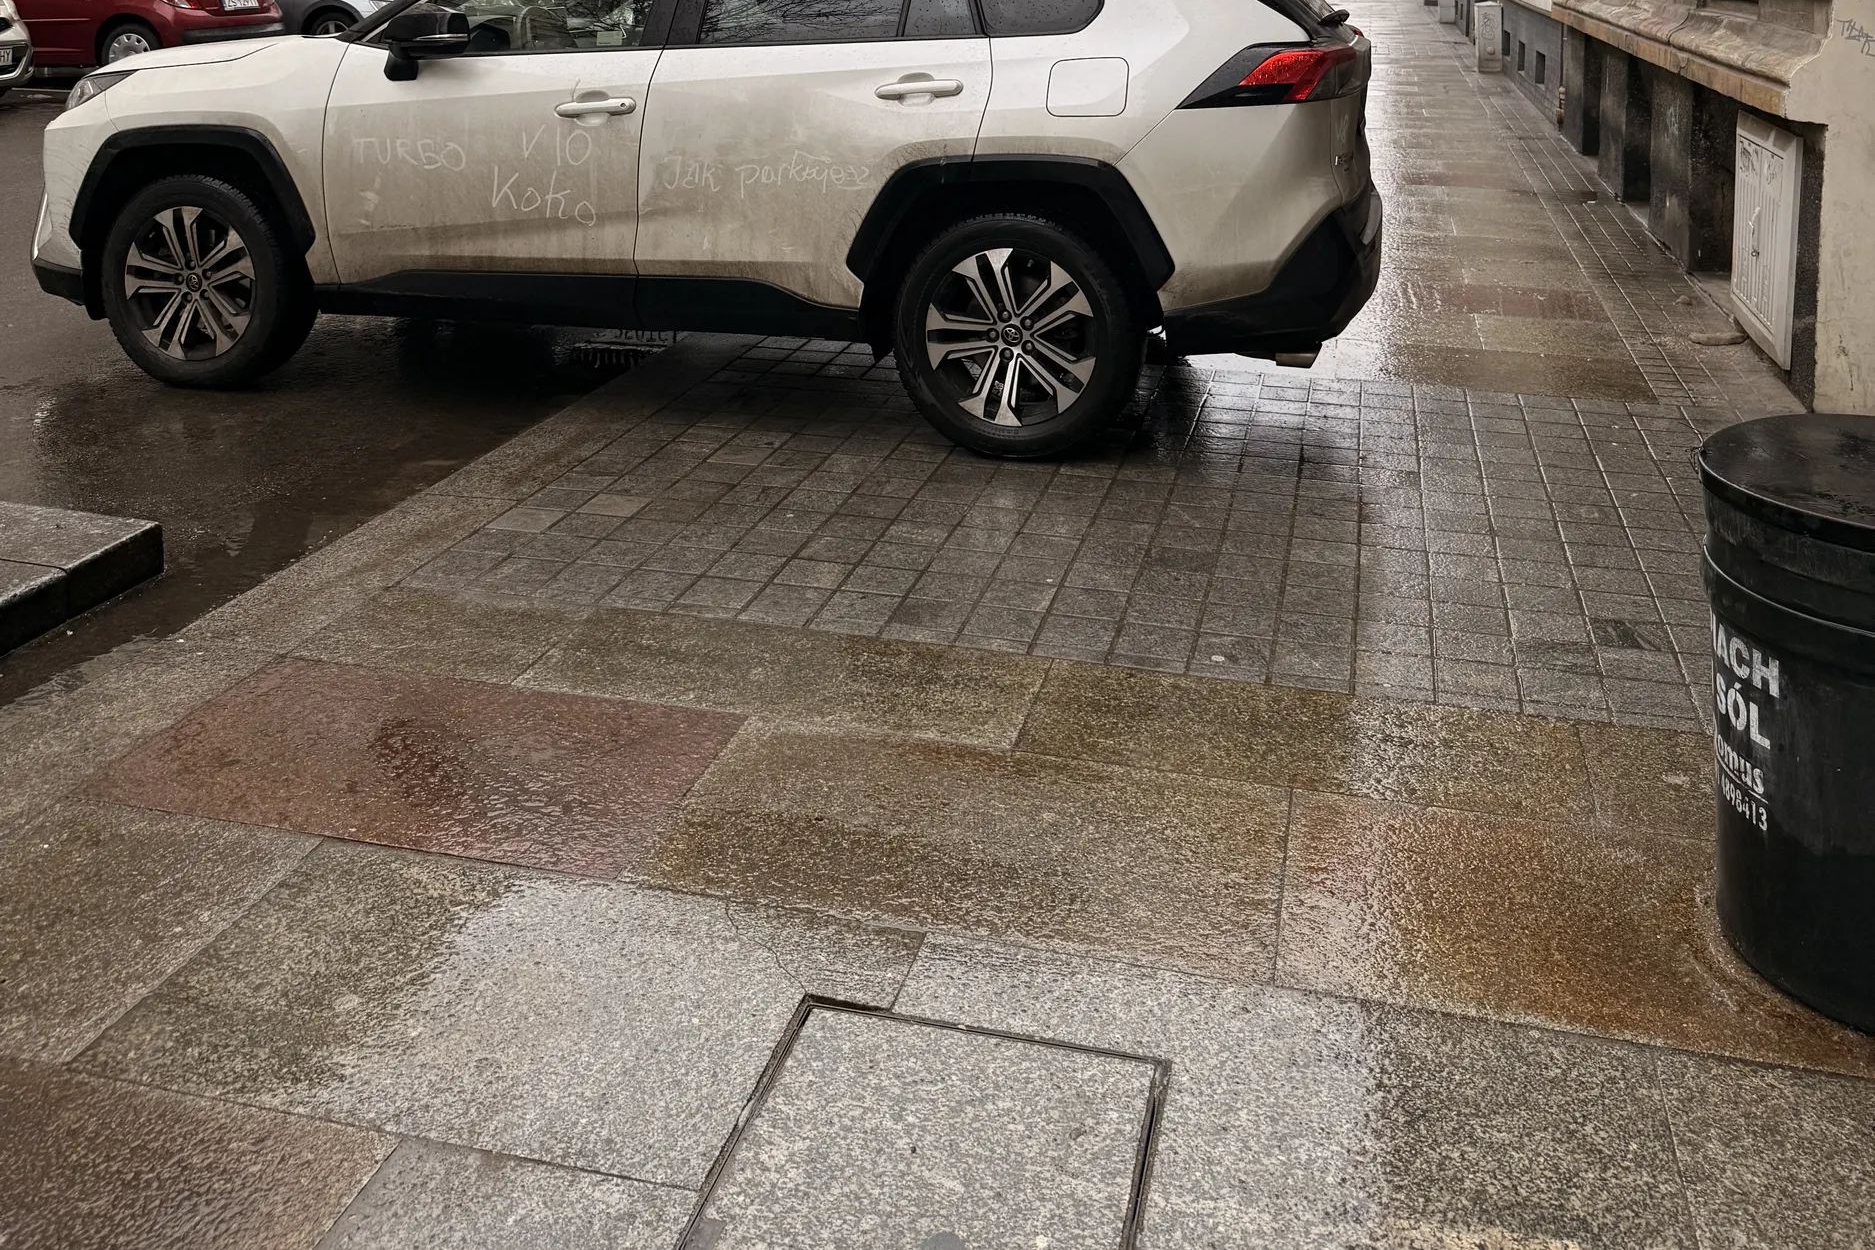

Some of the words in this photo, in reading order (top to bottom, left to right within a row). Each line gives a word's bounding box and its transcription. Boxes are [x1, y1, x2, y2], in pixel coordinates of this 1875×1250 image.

[354, 137, 467, 171] TURBO
[1716, 672, 1771, 750] SÓL
[1715, 733, 1765, 795] omus
